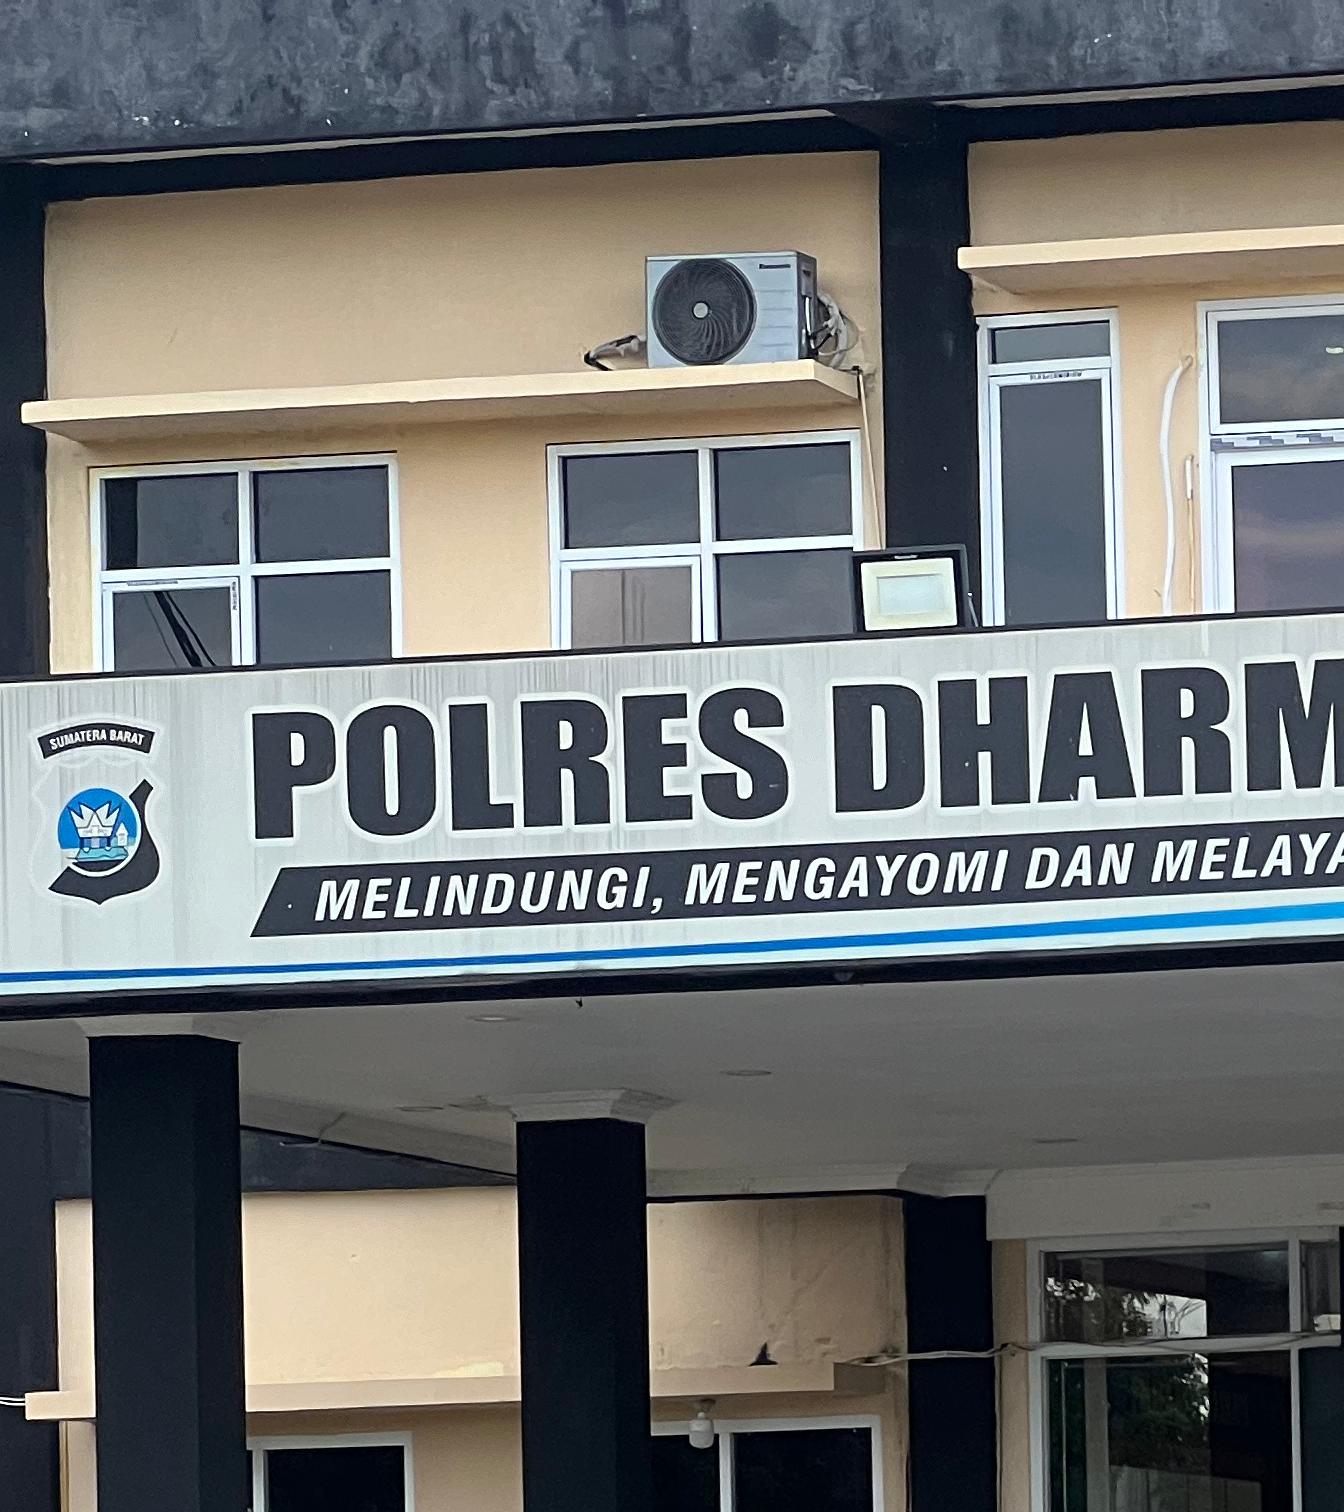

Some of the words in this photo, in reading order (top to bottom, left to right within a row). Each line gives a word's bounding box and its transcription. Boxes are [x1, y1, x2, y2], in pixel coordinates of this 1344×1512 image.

[49, 729, 107, 750] SUMATERA
[109, 729, 145, 746] BARAT
[252, 687, 789, 839] POLRES
[314, 866, 663, 922] MELINDUNGI,
[684, 849, 1008, 906] MENGAYOMI
[1025, 842, 1135, 891] DAN
